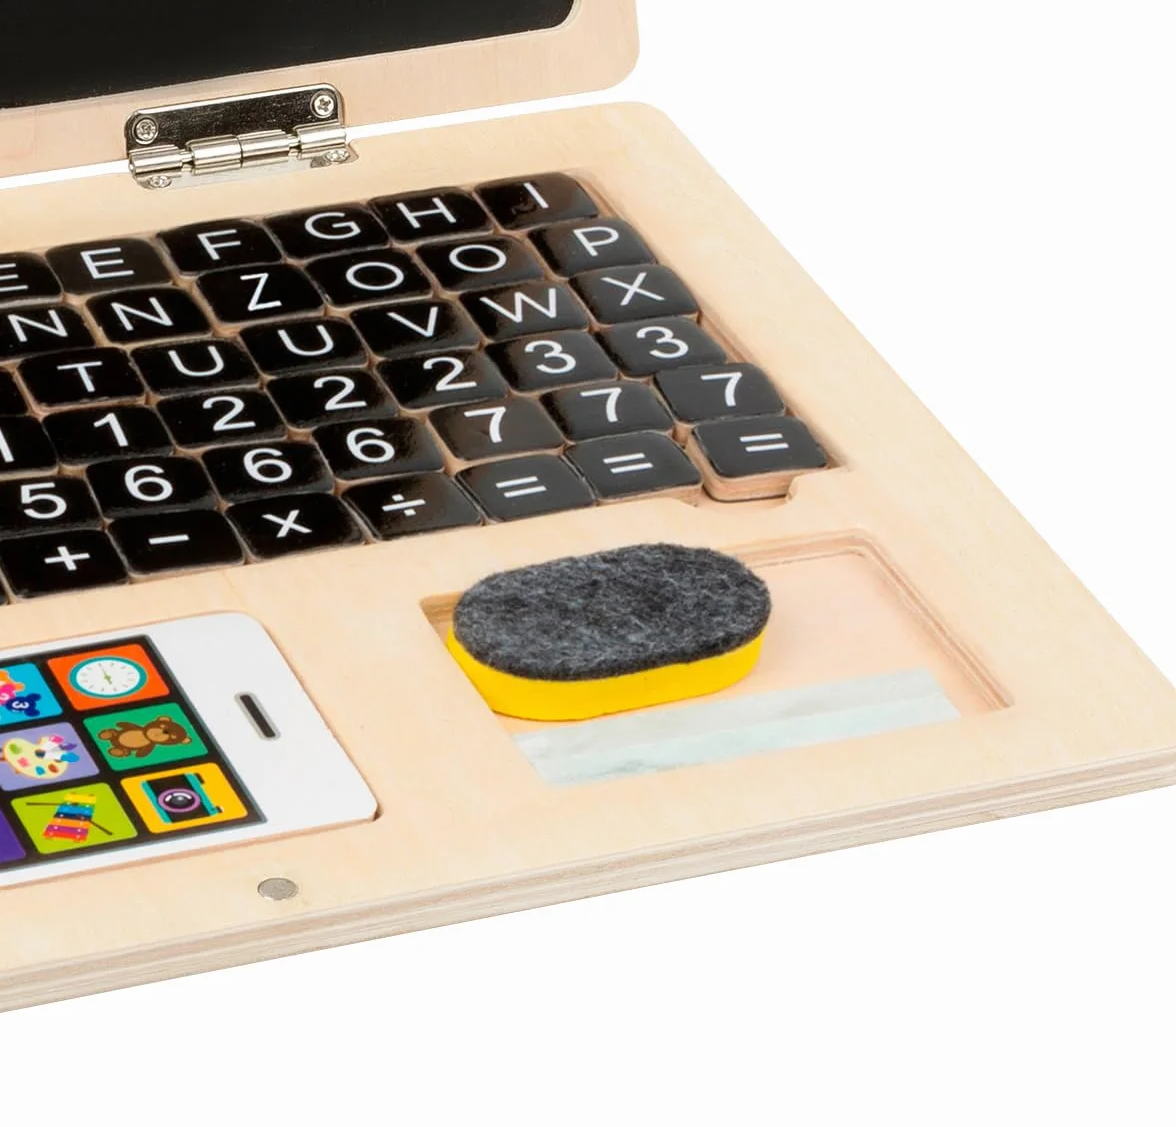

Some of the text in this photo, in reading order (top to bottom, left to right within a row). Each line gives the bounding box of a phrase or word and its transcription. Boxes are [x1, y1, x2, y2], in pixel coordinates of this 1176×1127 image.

[7, 309, 68, 342] N
[111, 297, 173, 331] N
[240, 272, 282, 311] Z
[345, 261, 404, 291] O
[449, 244, 507, 273] O
[573, 225, 620, 257] P
[80, 247, 134, 279] E
[197, 229, 241, 260] F
[304, 212, 361, 240] G
[396, 197, 457, 228] H
[523, 182, 549, 209] I
[57, 361, 102, 392] T
[168, 345, 224, 377] U
[277, 324, 334, 356] U
[387, 306, 438, 337] V
[480, 287, 557, 323] W
[601, 271, 665, 306] X
[93, 412, 129, 447] 1
[202, 396, 256, 431] 2
[313, 375, 367, 411] 2
[423, 356, 478, 392] 2
[524, 339, 577, 374] 3
[635, 325, 689, 359] 3
[20, 482, 67, 519] 5
[124, 465, 173, 502] 6
[243, 448, 292, 483] 6
[346, 427, 395, 463] 6
[463, 405, 507, 444] 7
[579, 386, 623, 424] 7
[700, 371, 743, 407] 7
[11, 700, 30, 709] 3
